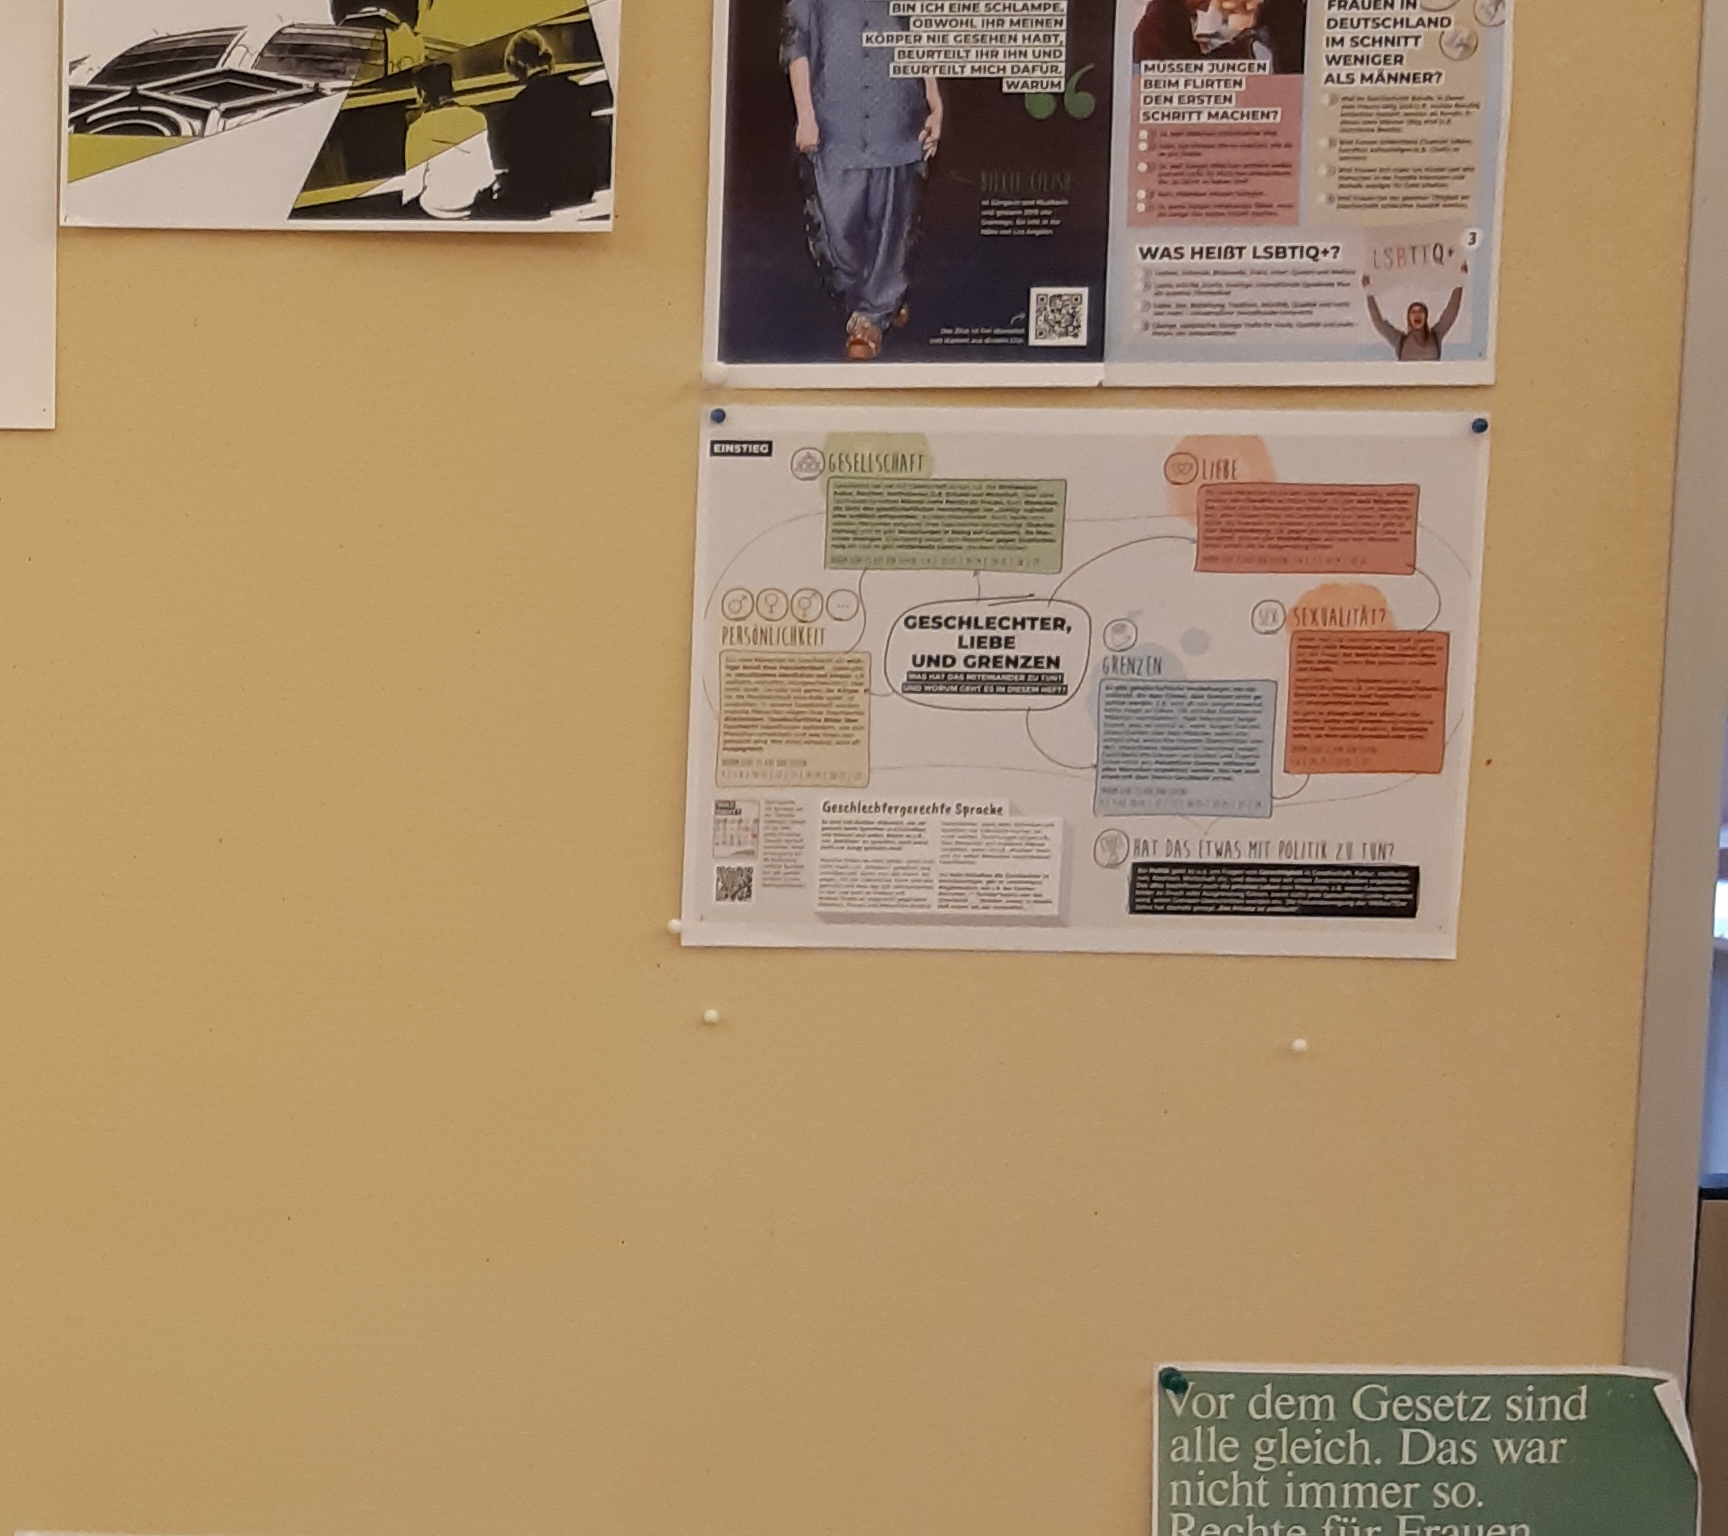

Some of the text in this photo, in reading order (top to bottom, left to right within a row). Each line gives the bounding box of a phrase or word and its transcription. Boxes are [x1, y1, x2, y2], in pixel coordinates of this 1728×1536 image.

[1326, 17, 1452, 29] DEUTSCHLAND
[1325, 36, 1422, 47] IM SCHNITT
[1325, 54, 1404, 66] WENIGER
[1324, 68, 1442, 85] ALS MÄNNER?
[1139, 247, 1184, 260] WAS
[1252, 245, 1340, 262] LSBTIQ+?
[713, 443, 769, 454] EINSTIEG
[828, 454, 925, 473] GESELLSCHAFT
[904, 616, 1072, 634] GESCHLECHTER,
[958, 636, 1015, 649] LIEBE
[912, 654, 1060, 669] UND GRENZEN
[1168, 1382, 1589, 1423] Vor dem Gesetz sind
[1170, 1428, 1567, 1472] alle gleich. Das war
[1170, 1472, 1484, 1508] nicht immer so.
